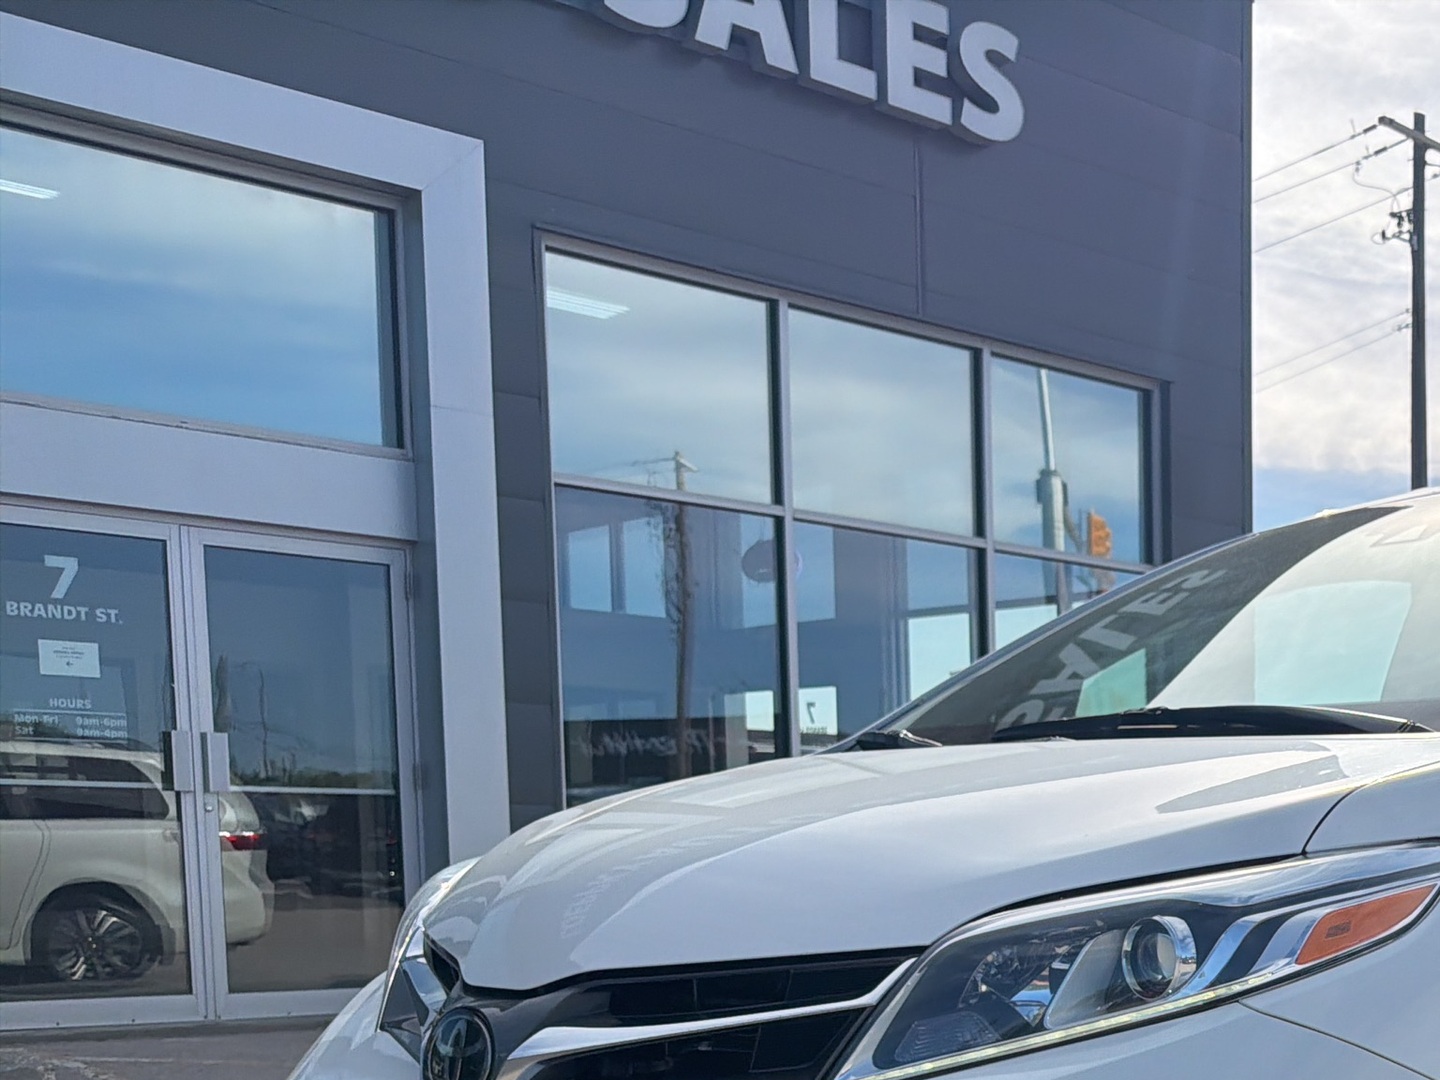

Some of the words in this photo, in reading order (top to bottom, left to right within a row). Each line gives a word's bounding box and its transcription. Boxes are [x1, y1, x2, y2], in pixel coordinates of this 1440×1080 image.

[602, 0, 1025, 143] ALES
[44, 554, 79, 599] 7
[5, 600, 89, 621] BRANDT
[95, 607, 124, 625] ST.
[49, 697, 92, 709] HOURS
[15, 725, 34, 735] Sat
